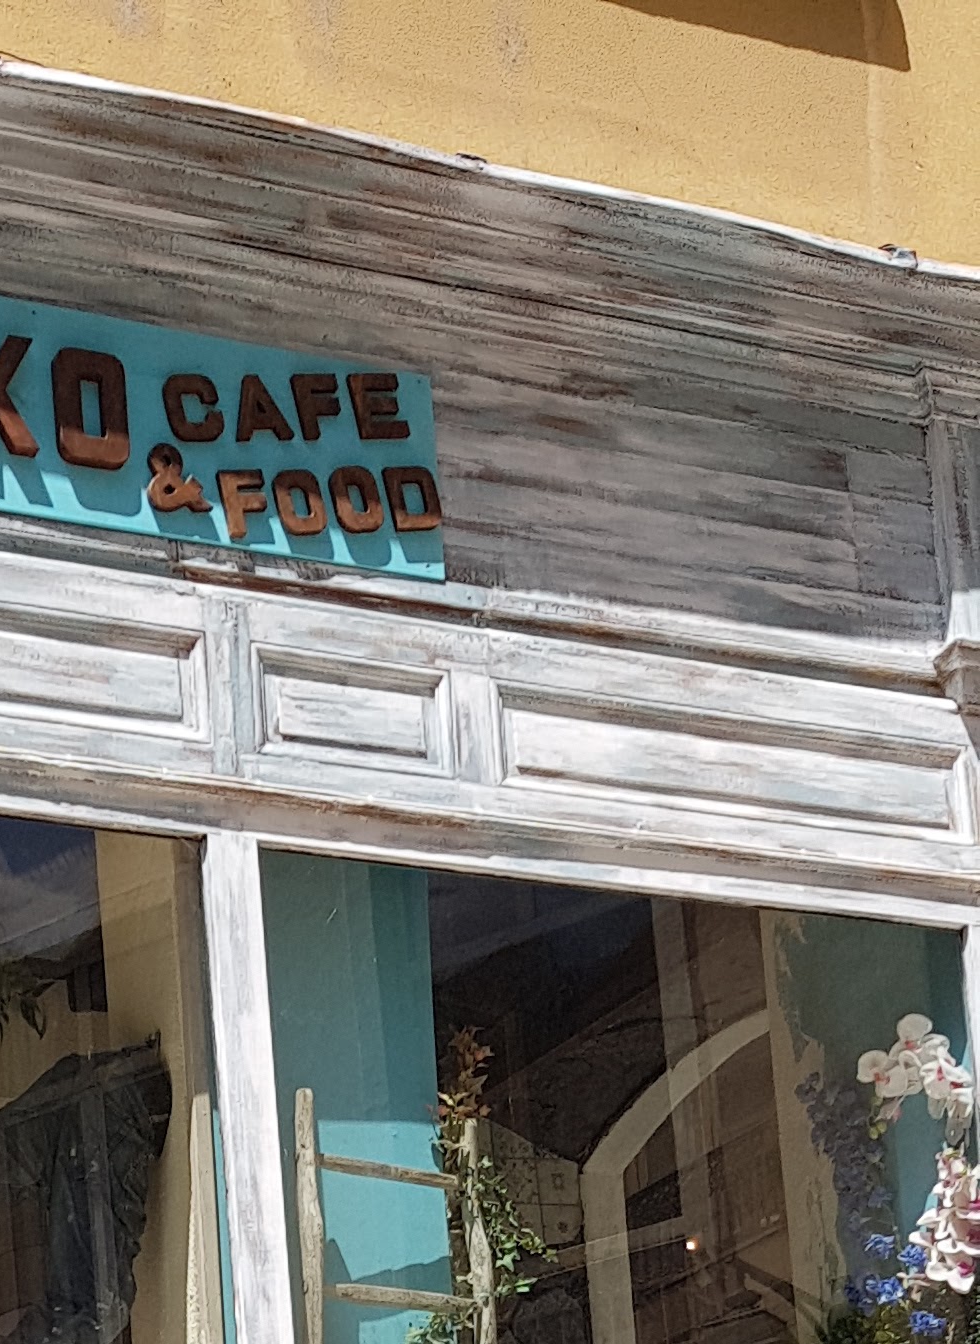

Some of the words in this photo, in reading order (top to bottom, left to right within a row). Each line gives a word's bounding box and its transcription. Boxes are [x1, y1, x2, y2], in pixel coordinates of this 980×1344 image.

[161, 372, 411, 443] CAFE
[146, 443, 212, 513] &
[216, 465, 442, 539] FOOD
